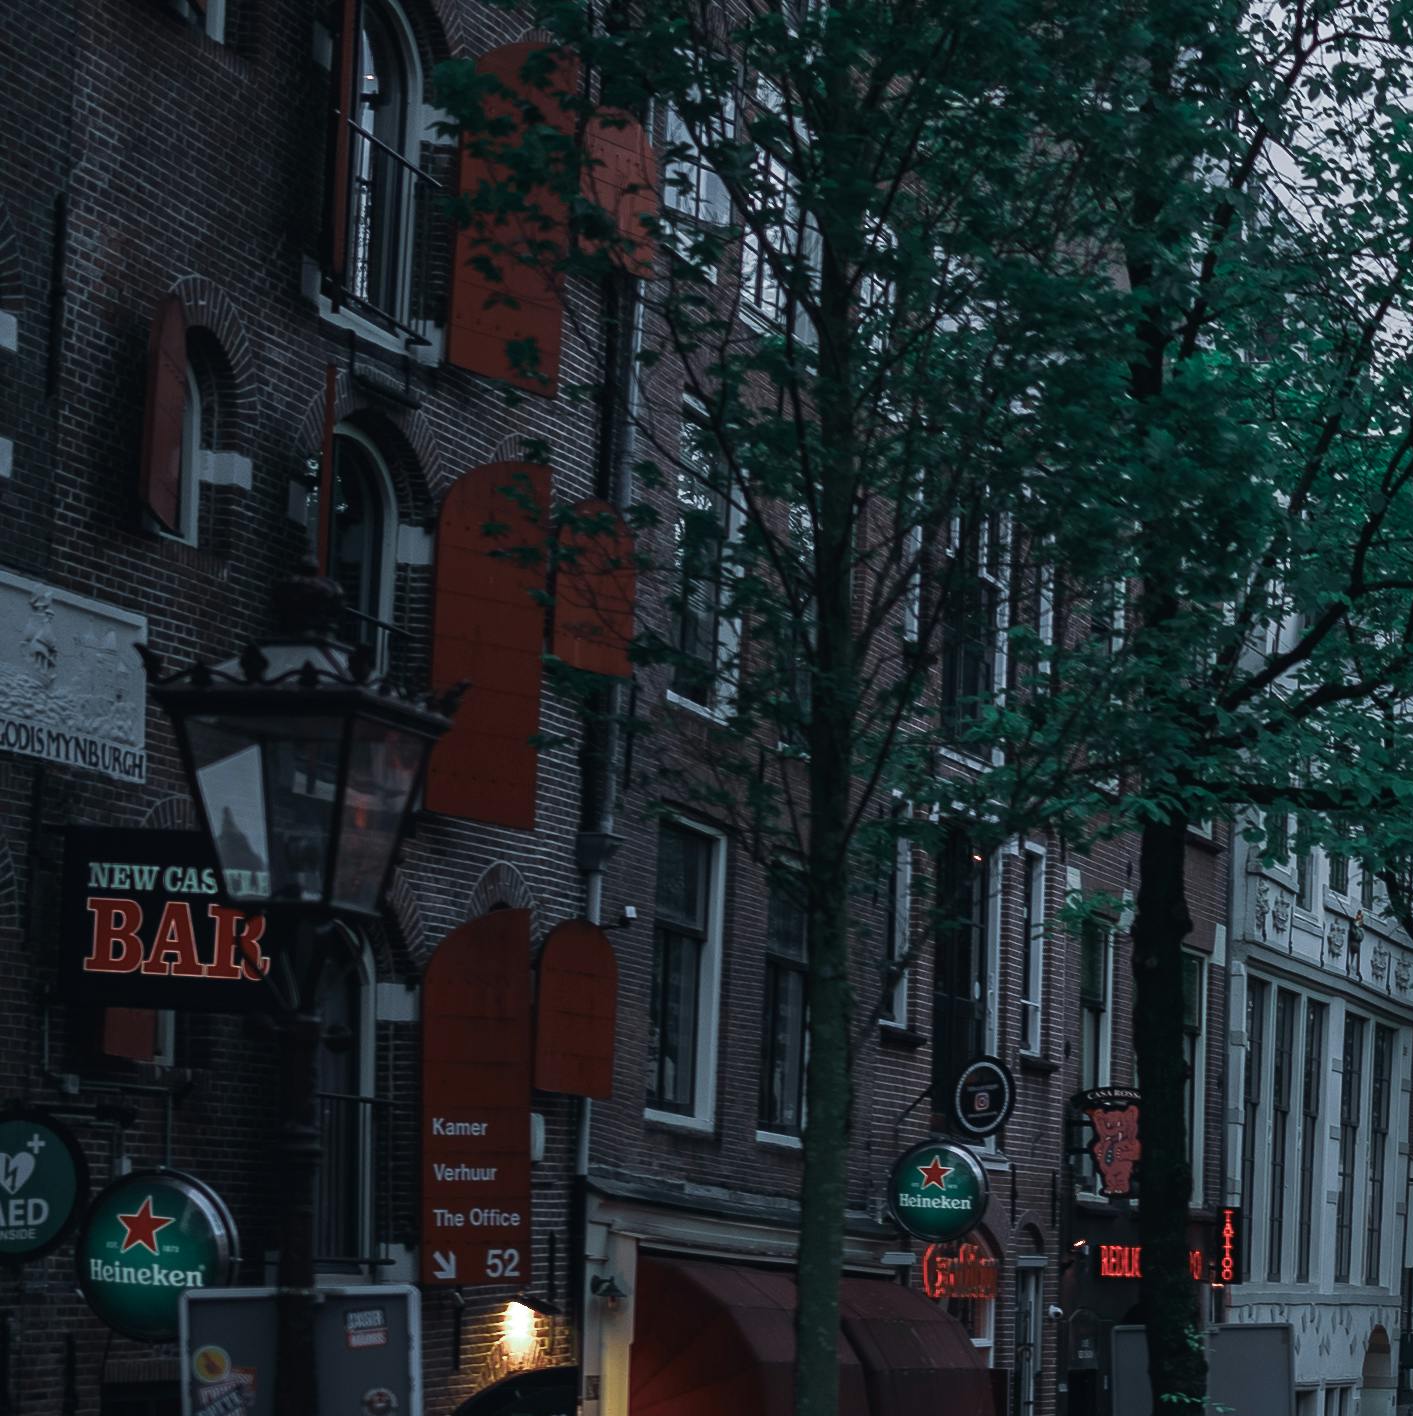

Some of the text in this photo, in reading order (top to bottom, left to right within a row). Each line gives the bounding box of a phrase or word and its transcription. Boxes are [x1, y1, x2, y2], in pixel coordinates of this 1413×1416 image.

[88, 862, 160, 891] NEW
[83, 896, 271, 982] BAR
[432, 1117, 489, 1136] Kamer
[433, 1163, 498, 1182] Verhuur
[898, 1192, 974, 1211] Heineken
[432, 1208, 521, 1227] The Office
[0, 1228, 38, 1241] NSIDE
[1222, 1209, 1236, 1281] TATTOO
[89, 1258, 205, 1288] Heineken
[485, 1248, 520, 1278] 52
